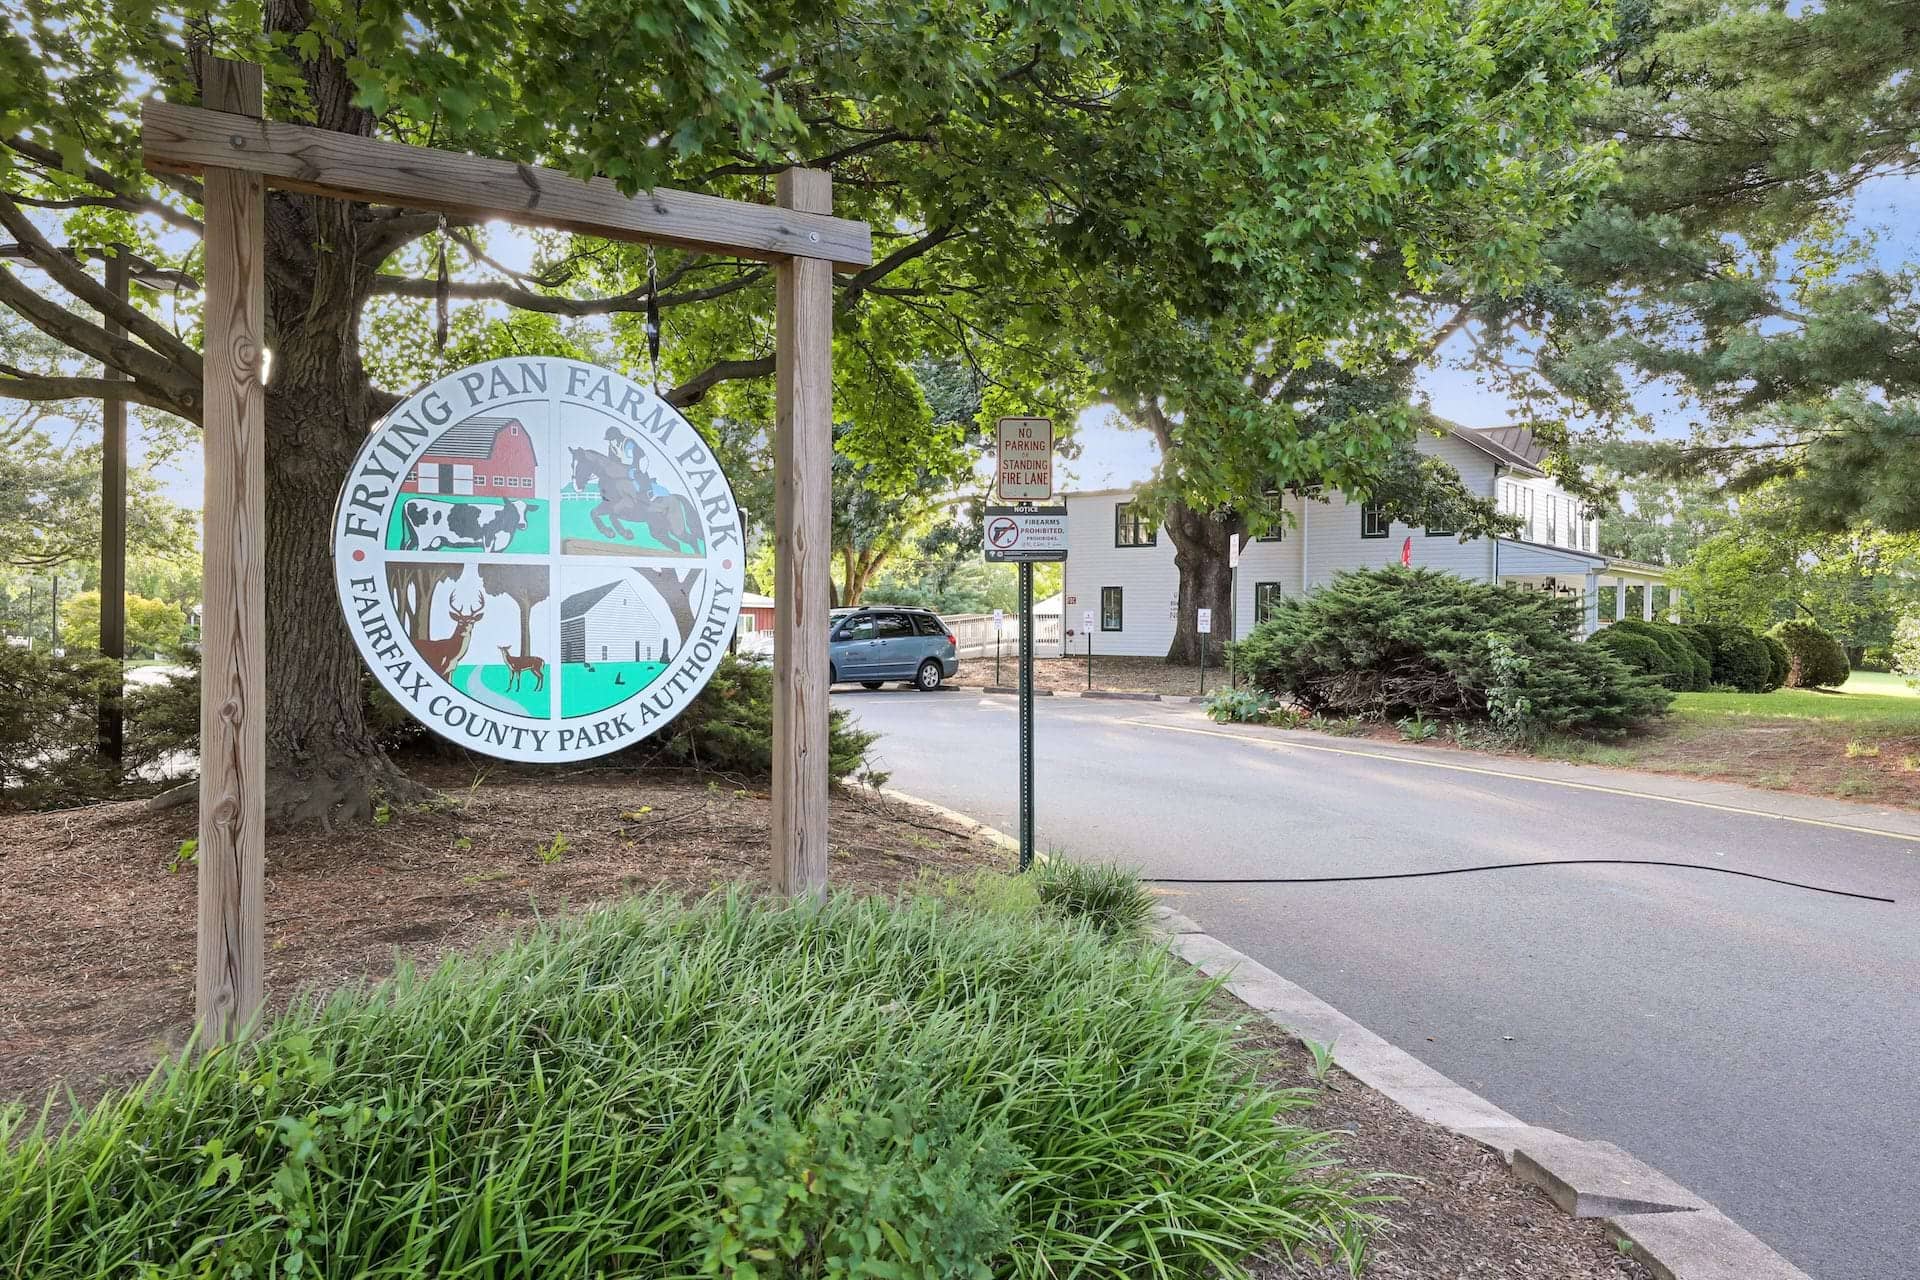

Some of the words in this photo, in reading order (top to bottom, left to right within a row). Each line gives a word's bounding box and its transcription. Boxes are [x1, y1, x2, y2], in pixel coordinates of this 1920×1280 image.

[1018, 428, 1033, 438] NO
[1005, 440, 1046, 451] PARKING
[344, 391, 453, 541] FRYING
[458, 362, 549, 407] PAN
[564, 365, 681, 445] FARM
[674, 441, 739, 551] PARK
[1002, 459, 1048, 470] STANDING
[1002, 472, 1021, 485] FIRE
[1025, 472, 1049, 485] LANE
[350, 575, 432, 703] FAIRFAX
[428, 695, 549, 752] COUNTY
[558, 713, 635, 752] PARK
[641, 580, 734, 725] AUTHORITY
